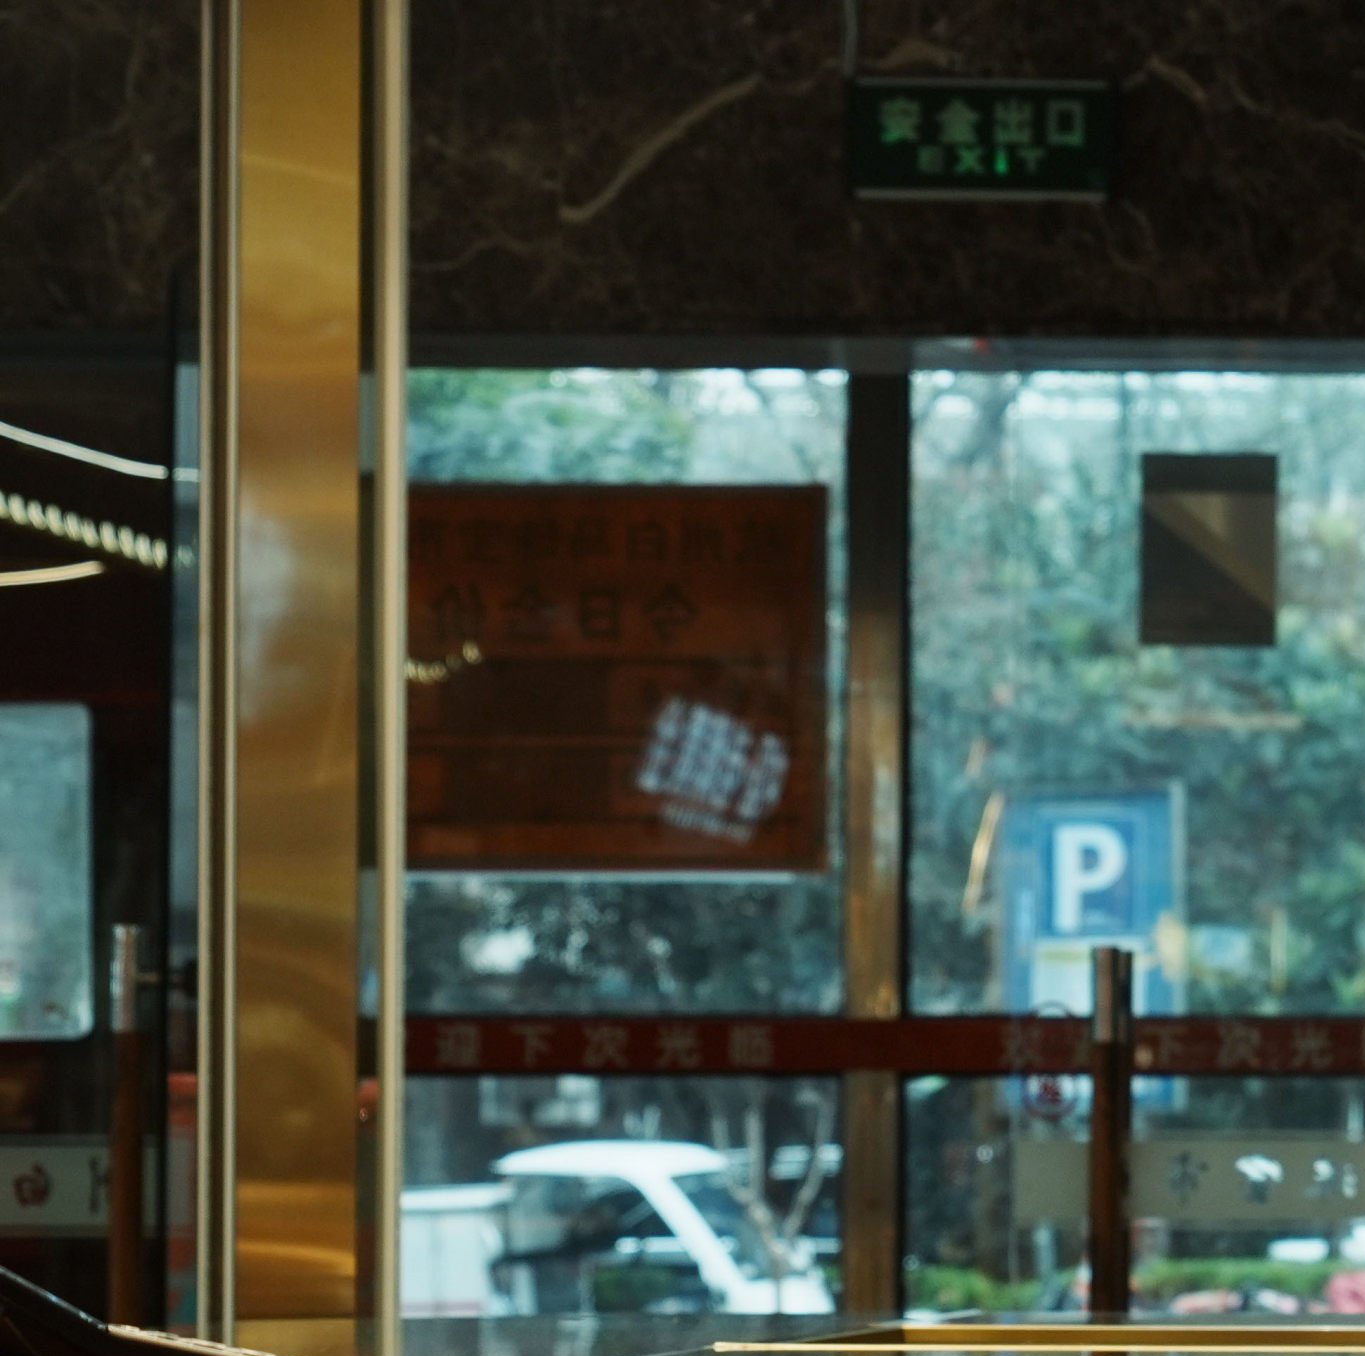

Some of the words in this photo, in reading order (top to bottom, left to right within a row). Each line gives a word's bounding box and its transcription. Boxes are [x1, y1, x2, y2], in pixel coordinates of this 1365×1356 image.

[880, 97, 1086, 146] 安全出口
[917, 146, 1046, 175] EXIT
[1051, 822, 1129, 933] P
